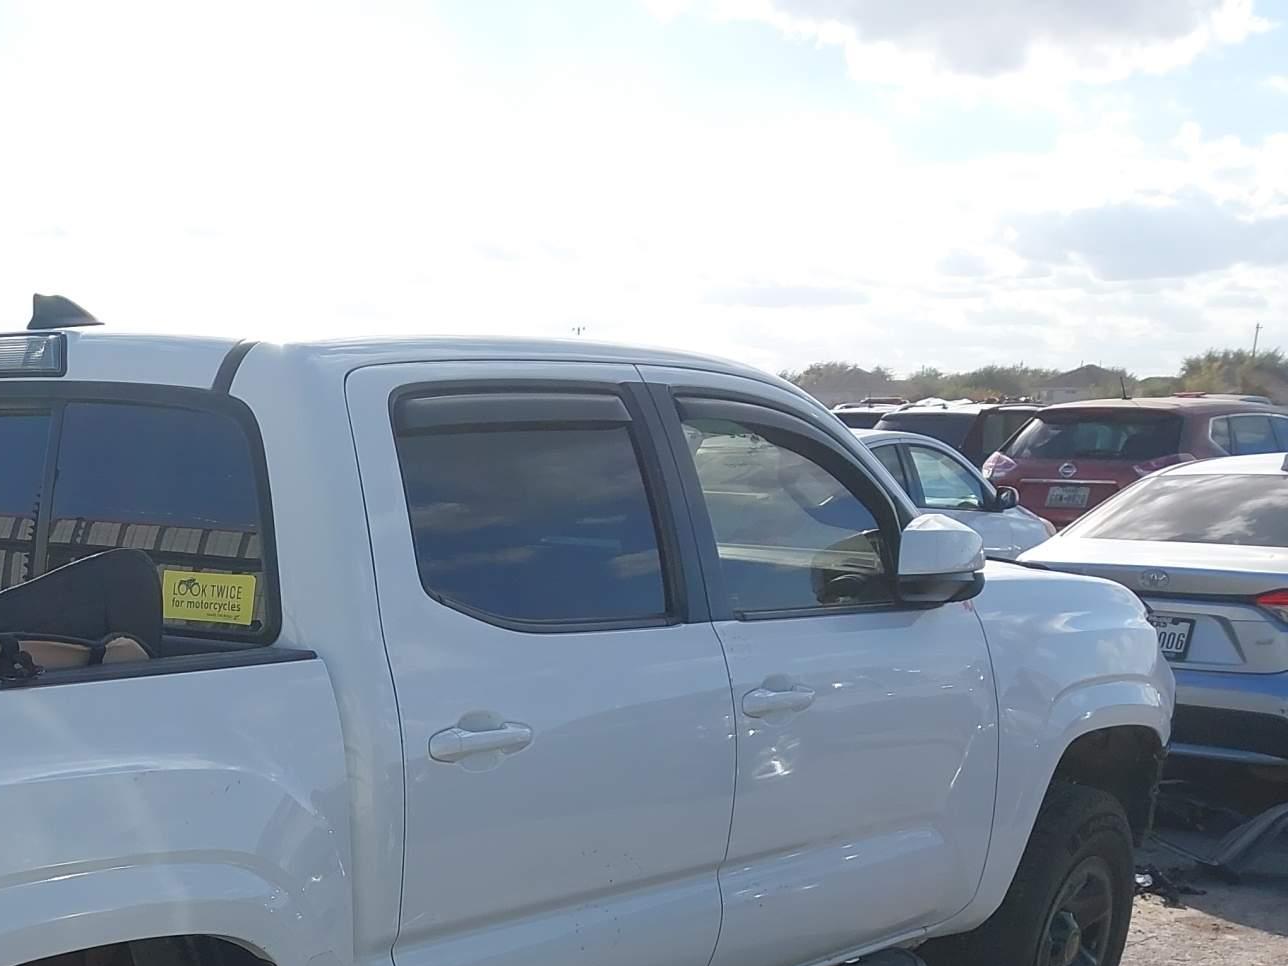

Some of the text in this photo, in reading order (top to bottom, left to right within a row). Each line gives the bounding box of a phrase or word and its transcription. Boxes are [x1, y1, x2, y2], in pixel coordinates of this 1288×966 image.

[173, 580, 243, 600] LOOK TWICE
[172, 597, 241, 612] for motorcycles
